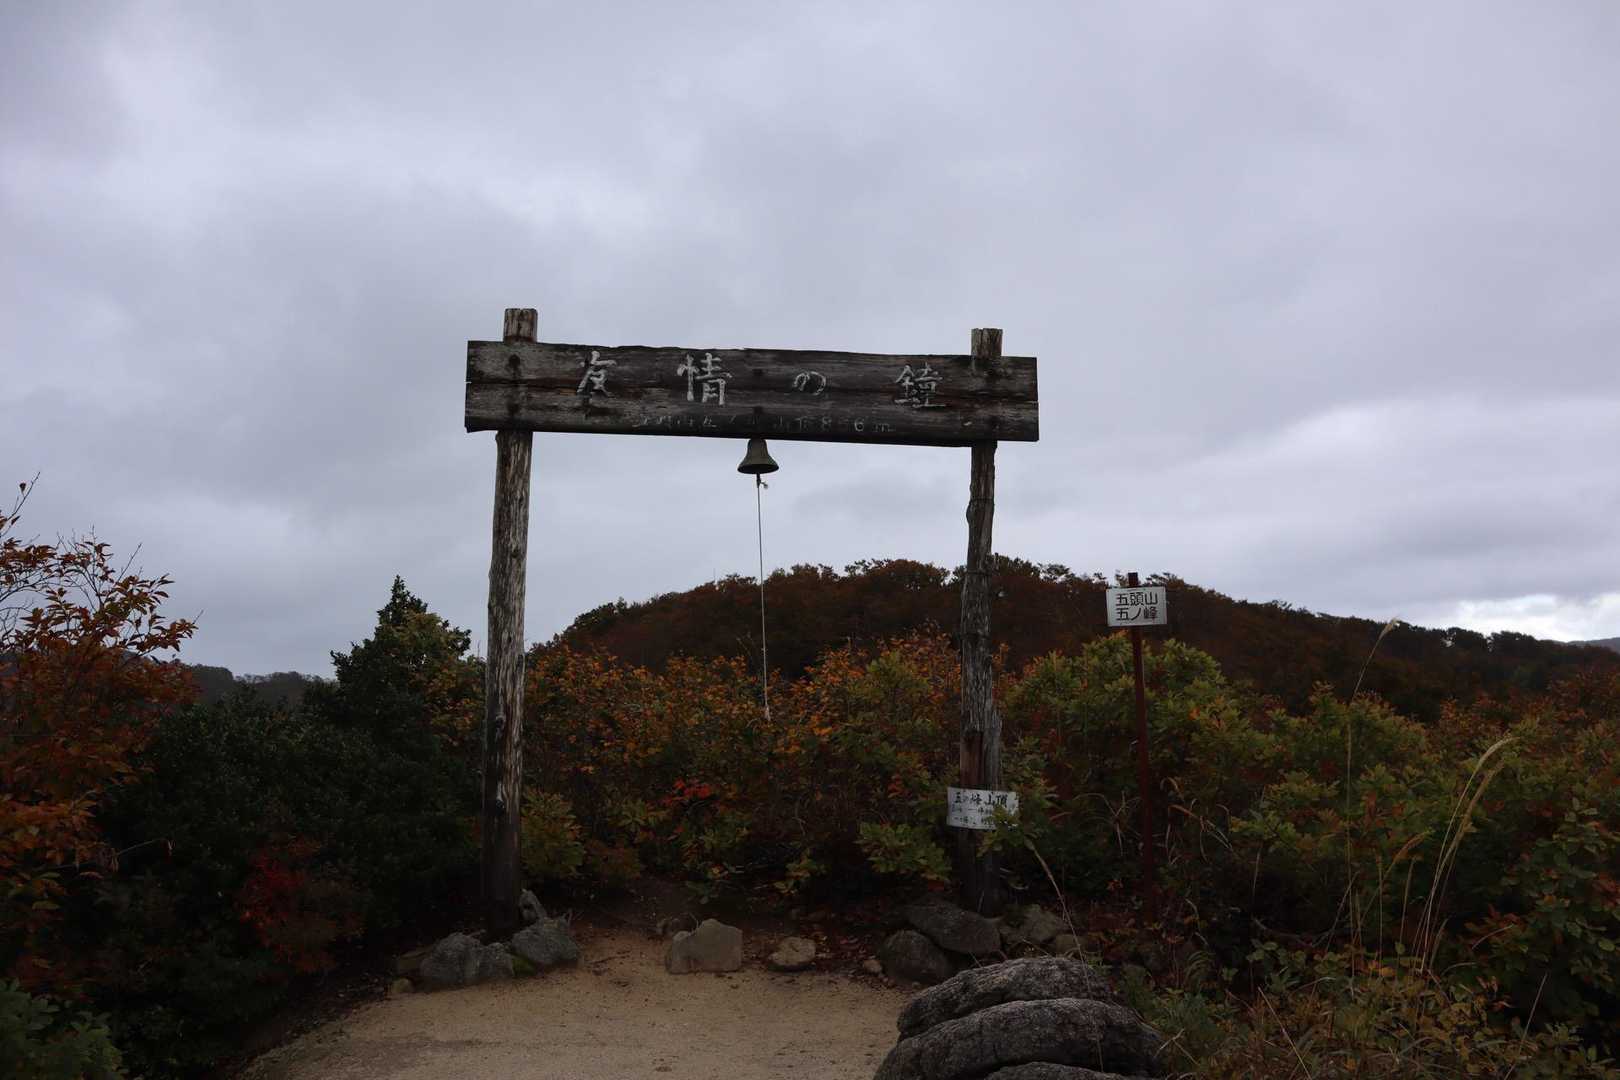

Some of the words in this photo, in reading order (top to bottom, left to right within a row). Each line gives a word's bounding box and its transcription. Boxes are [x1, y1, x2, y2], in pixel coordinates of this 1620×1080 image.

[575, 349, 947, 408] 友情の鐘
[1115, 592, 1159, 607] 五頭山
[1116, 606, 1159, 621] 五ノ峰
